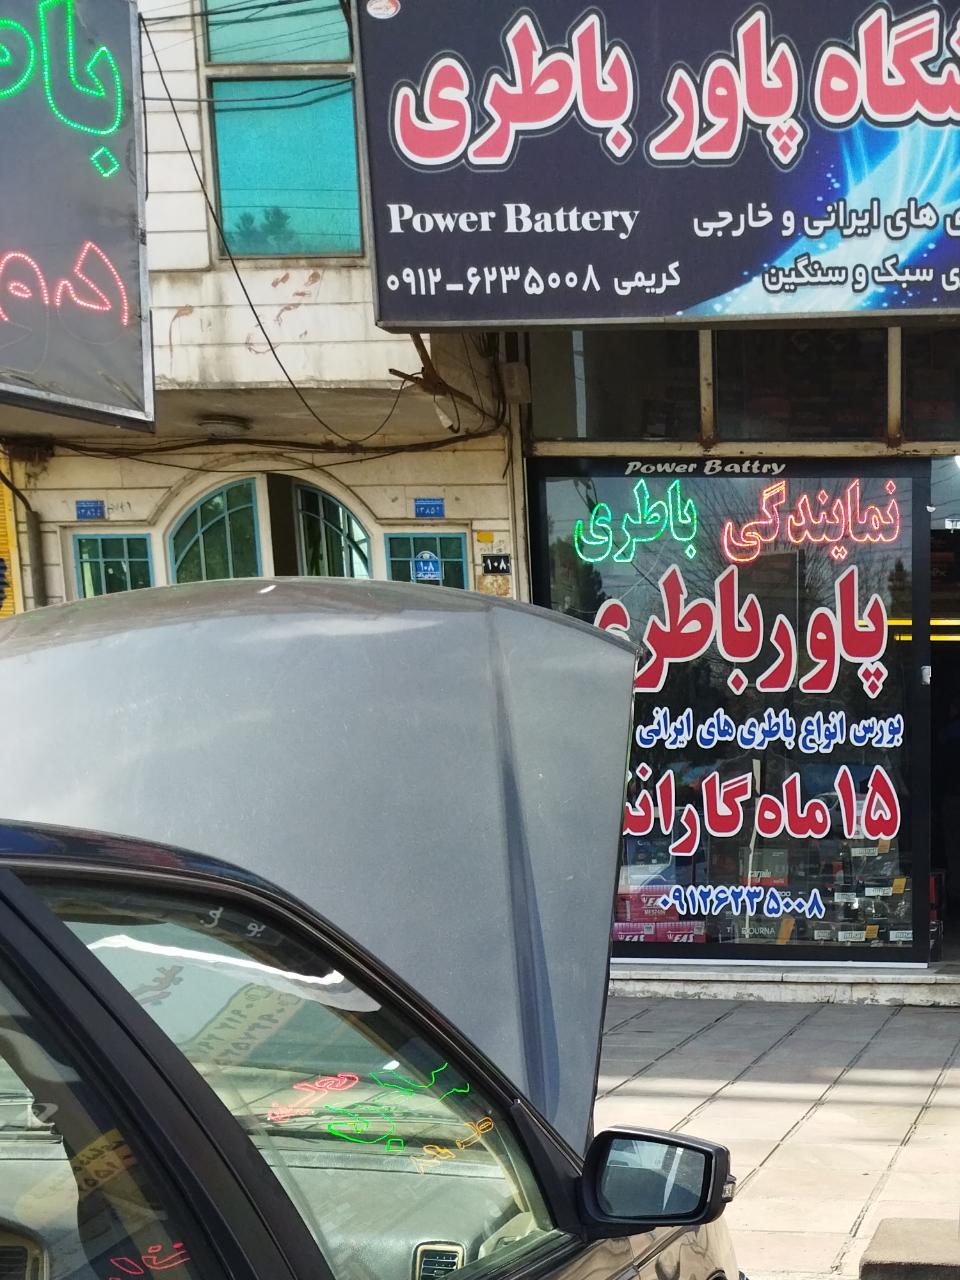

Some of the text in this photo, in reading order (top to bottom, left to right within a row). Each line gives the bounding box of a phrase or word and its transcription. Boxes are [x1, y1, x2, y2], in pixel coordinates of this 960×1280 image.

[394, 14, 634, 166] باطری
[649, 10, 803, 165] پاور
[386, 203, 640, 240] Power Battery
[693, 203, 774, 238] خارجی
[781, 209, 796, 237] و
[804, 200, 879, 238] ایرانی
[885, 199, 938, 237] های
[386, 261, 681, 297] کریمی ۰۹۱۲-۶۲۳۵۰۰۸
[763, 258, 848, 292] سنگین
[852, 264, 867, 290] و
[873, 256, 933, 289] سبک
[625, 459, 786, 476] Power Battry
[574, 478, 901, 563] نمایندگی باطری
[419, 560, 435, 572] ۱۰۸
[486, 557, 507, 571] ۱۰۸
[636, 706, 904, 754] بورس انواع باطری های ایرانی
[623, 761, 901, 857] ۱۵ ماه گاران
[659, 884, 826, 919] ۰۹۱۲۶۲۳۵۰۰۸
